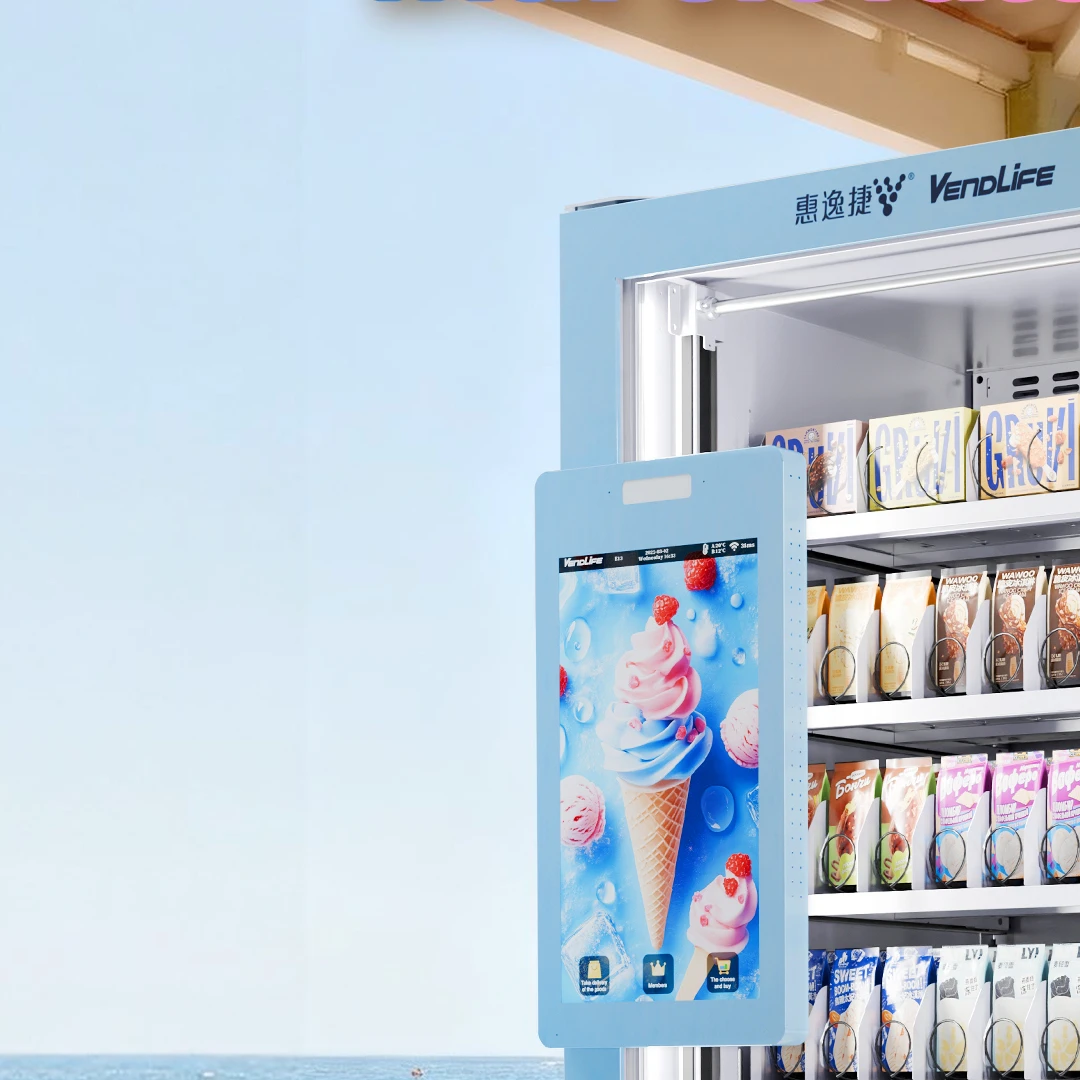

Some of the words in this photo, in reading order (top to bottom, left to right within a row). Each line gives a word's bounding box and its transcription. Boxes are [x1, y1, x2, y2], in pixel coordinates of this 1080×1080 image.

[795, 184, 872, 225] 惠逸捷
[1001, 570, 1036, 580] WAWOO
[833, 965, 869, 984] SWEET
